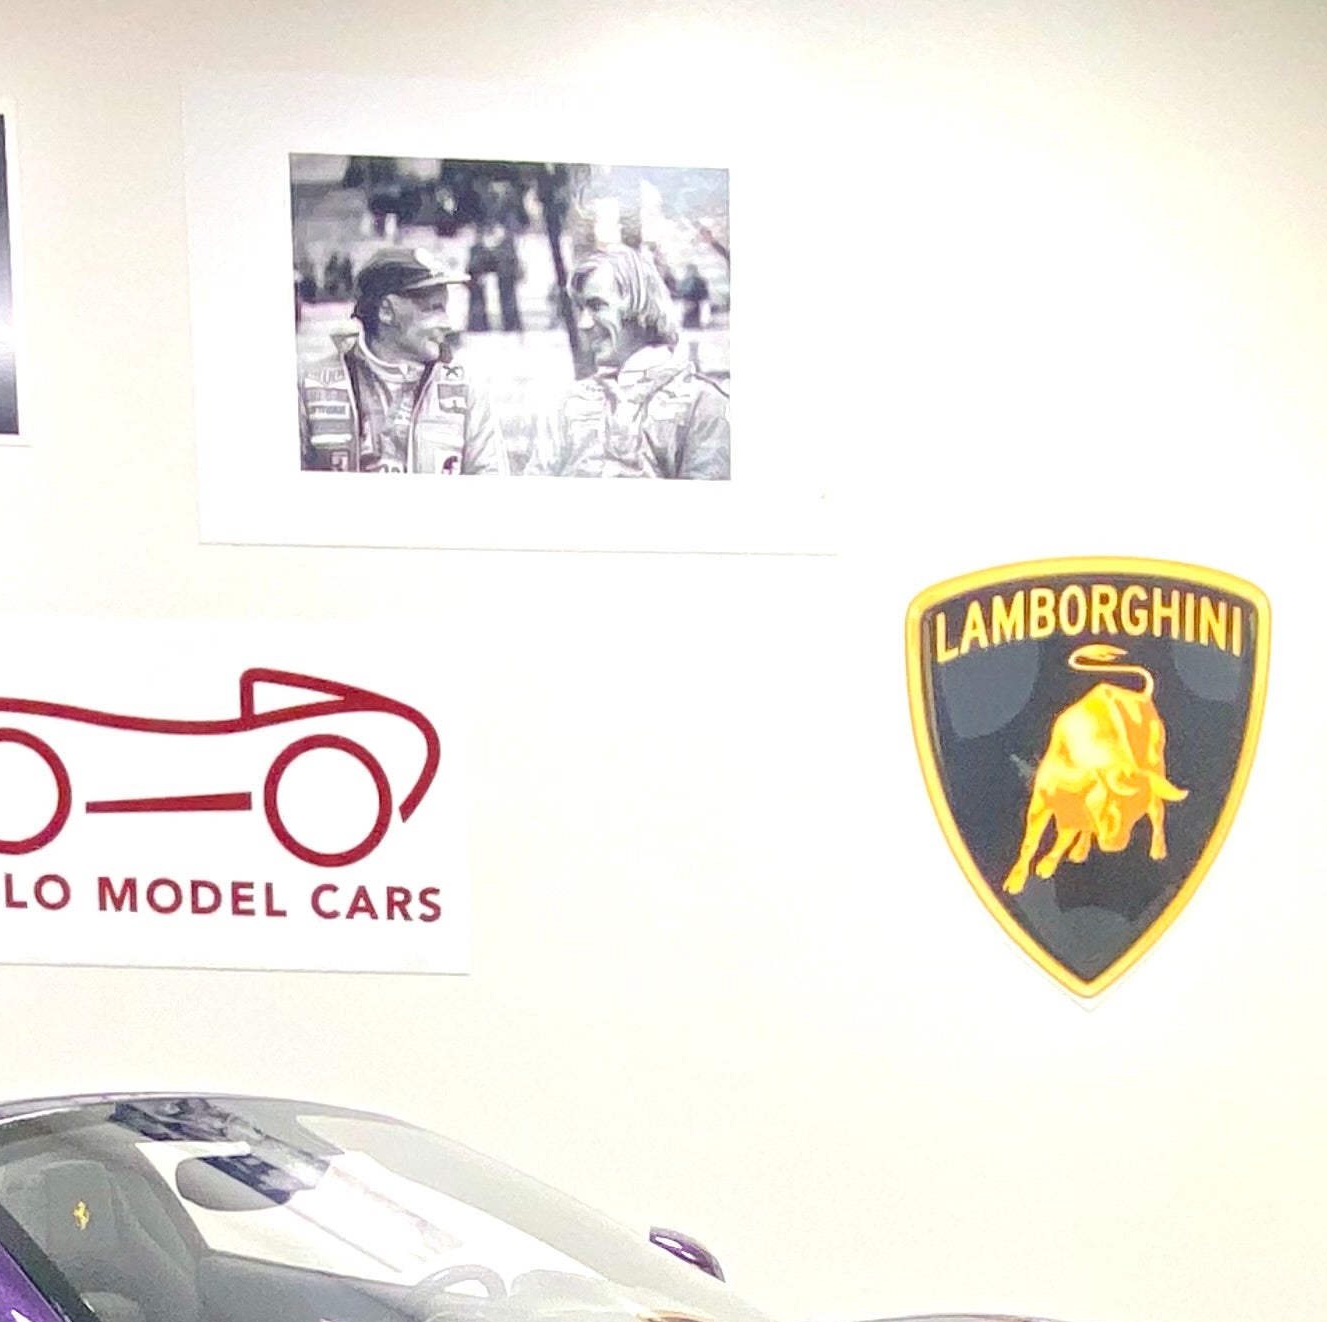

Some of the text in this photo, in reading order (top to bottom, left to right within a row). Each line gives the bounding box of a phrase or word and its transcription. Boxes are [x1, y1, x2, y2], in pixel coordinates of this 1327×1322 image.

[935, 583, 1244, 664] LAMBORGHINI
[97, 876, 288, 918] MODEL
[311, 883, 442, 923] CARS
